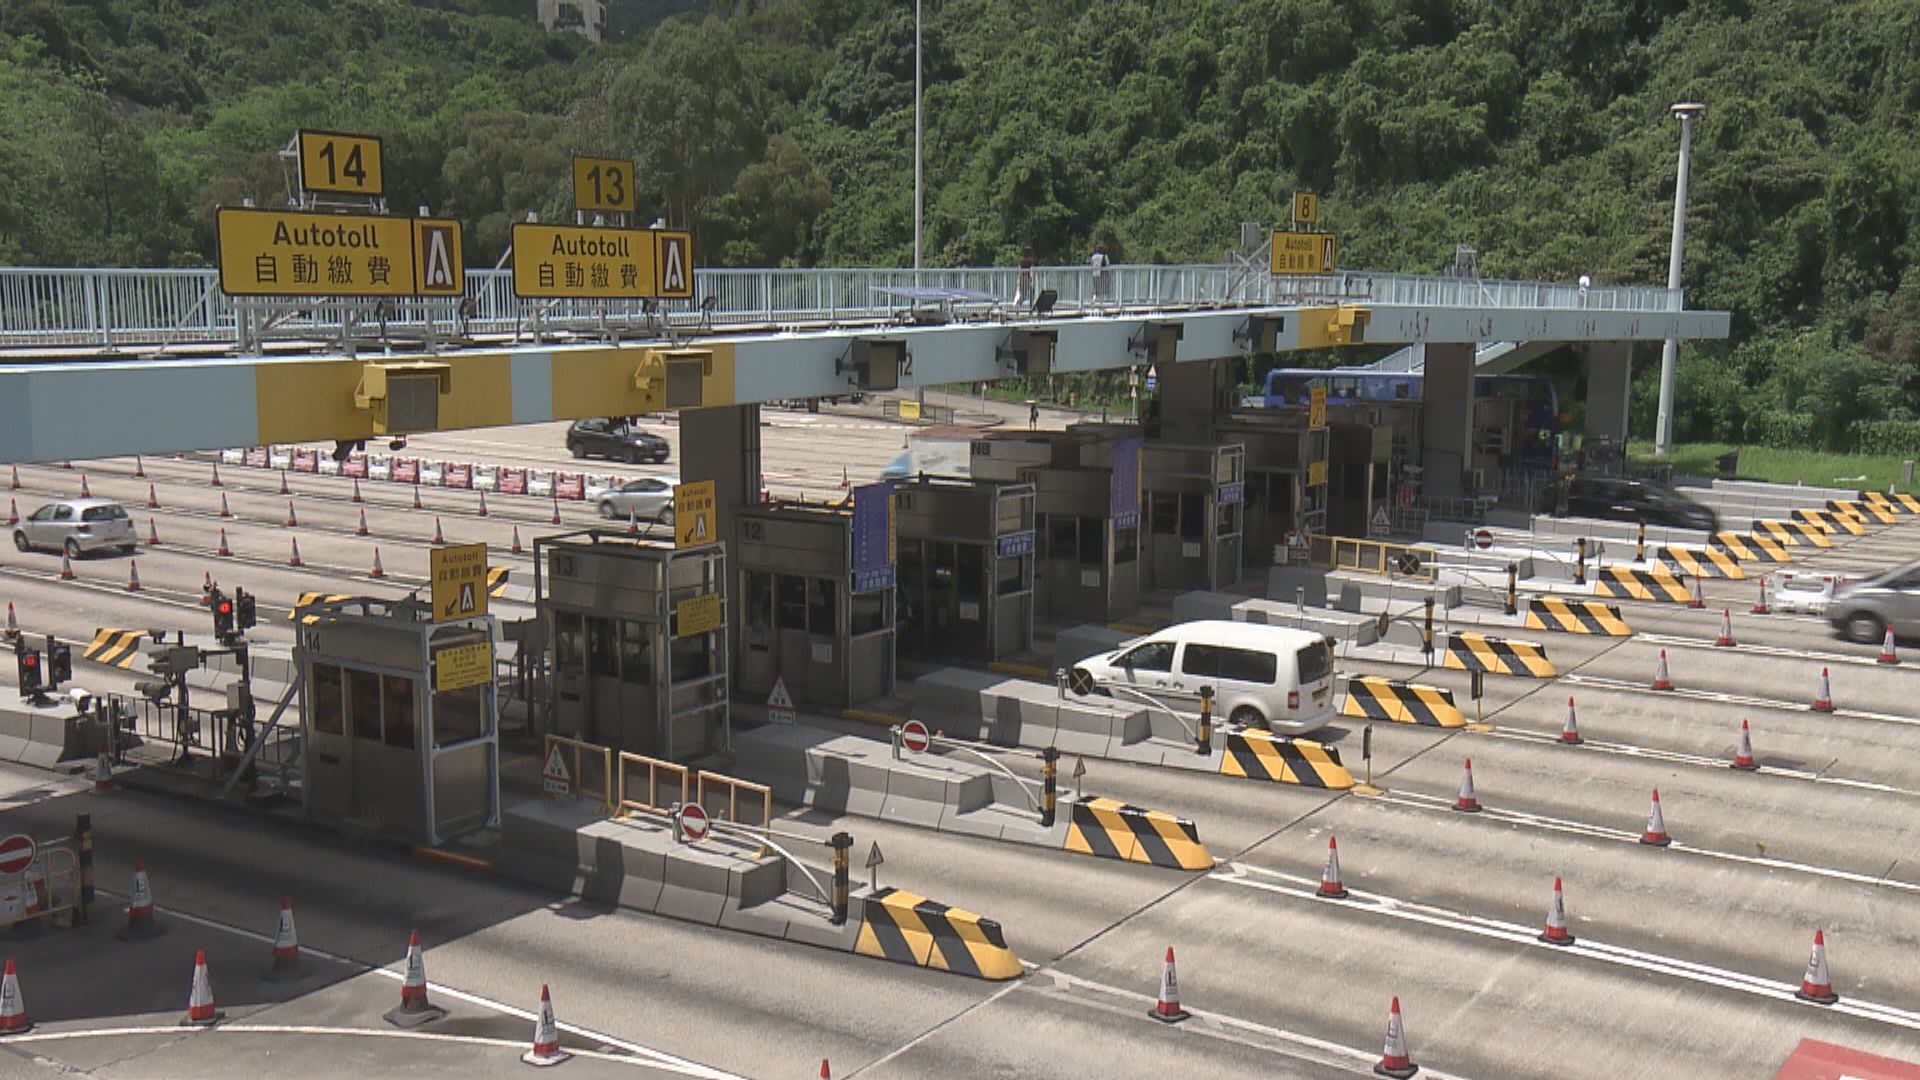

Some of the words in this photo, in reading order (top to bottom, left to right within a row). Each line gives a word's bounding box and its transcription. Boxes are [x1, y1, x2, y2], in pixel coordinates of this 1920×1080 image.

[318, 141, 368, 187] 14
[585, 165, 627, 207] 13
[1301, 195, 1310, 218] 8
[272, 220, 380, 250] Autotoll
[551, 233, 631, 258] Autotoll
[1285, 237, 1313, 251] Autotoll
[255, 253, 392, 285] 自動繳費
[537, 261, 639, 289] 自動繳費
[743, 521, 762, 540] 12
[441, 551, 479, 564] Autotoll
[554, 555, 574, 577] 13
[307, 631, 321, 655] 14
